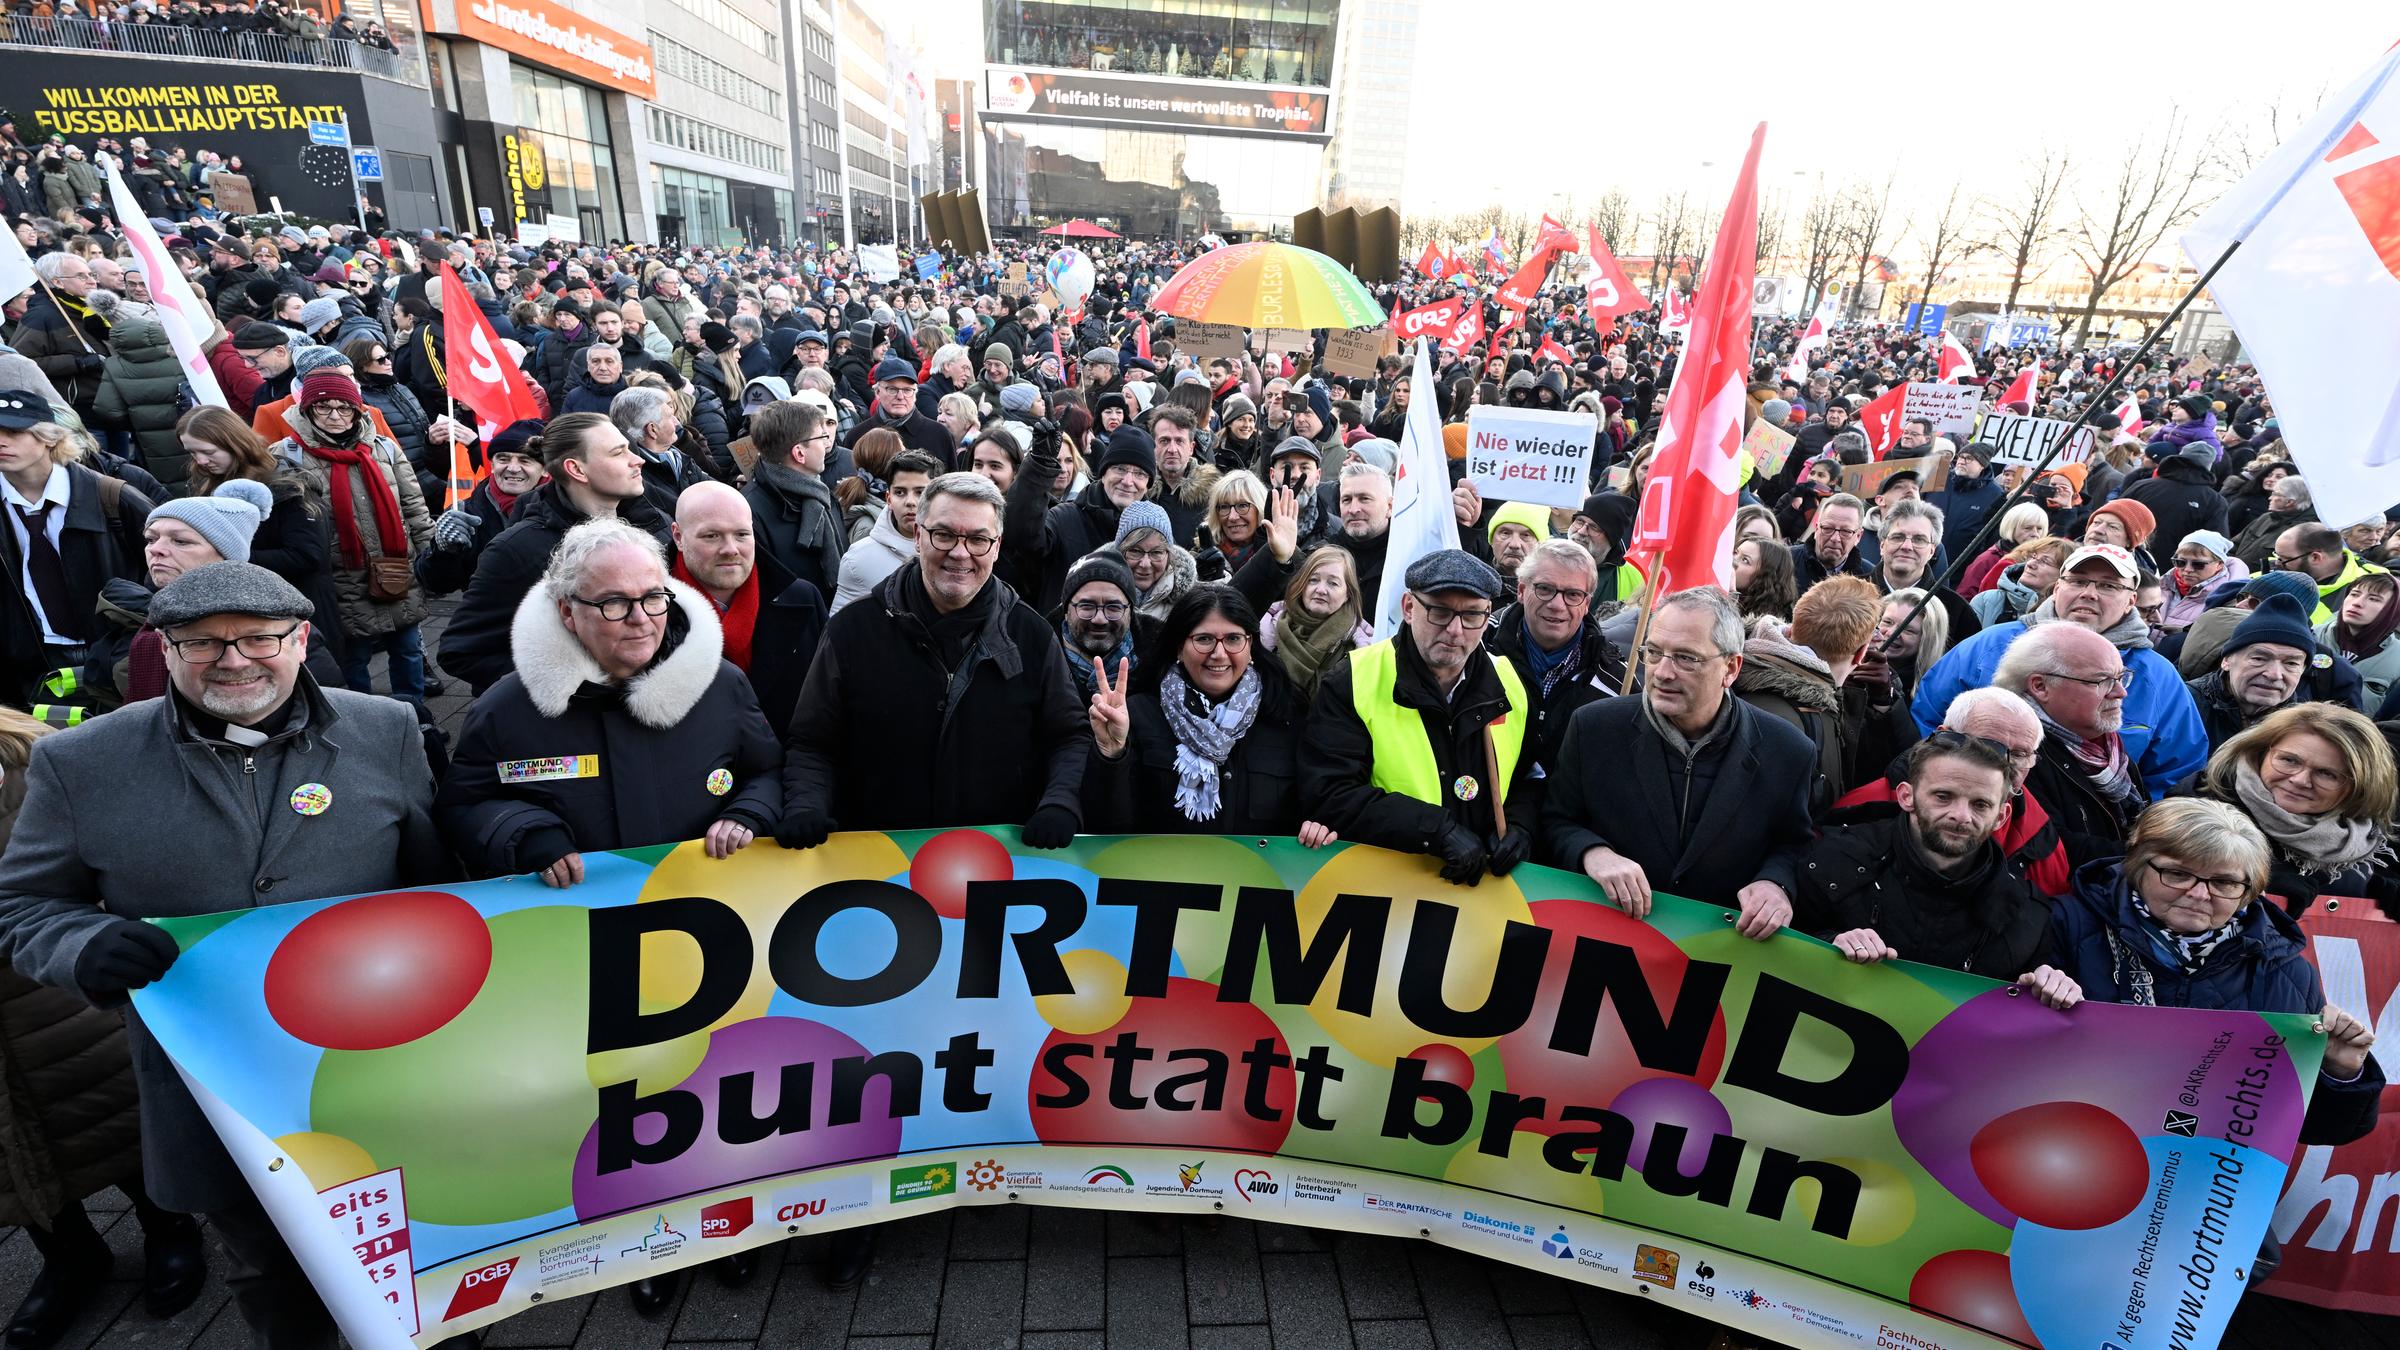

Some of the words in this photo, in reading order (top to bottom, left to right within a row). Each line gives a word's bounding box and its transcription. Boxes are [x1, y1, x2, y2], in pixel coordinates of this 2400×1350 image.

[43, 86, 200, 108] WILLKOMMEN
[199, 85, 229, 106] IN
[232, 84, 280, 105] DER
[1045, 88, 1101, 107] Vielfalt
[1103, 92, 1121, 109] ist
[1123, 97, 1169, 112] unsere
[1171, 98, 1250, 118] wertvollste
[1253, 103, 1314, 122] Trophäe.
[34, 105, 344, 134] FUSSBALLHAUPTSTADT!
[1336, 346, 1354, 360] 1933
[1475, 431, 1509, 451] Nie
[1515, 436, 1588, 459] wieder
[1471, 457, 1497, 476] ist
[1499, 460, 1548, 481] jetzt
[1554, 465, 1576, 484] !!!
[507, 758, 563, 770] DORTMUND
[587, 877, 1910, 1117] DORTMUND
[596, 1032, 994, 1177] bunt
[1035, 1032, 1344, 1131] statt
[1381, 1056, 1863, 1240] braun
[1006, 1175, 1042, 1185] Vielfalt
[1049, 1184, 1135, 1194] Auslandsgesellschaft.de
[1146, 1185, 1184, 1194] Jugendring
[1189, 1187, 1223, 1195] Dortmund
[1247, 1180, 1279, 1195] AWO
[1295, 1183, 1342, 1195] Unterbezirk
[1296, 1175, 1358, 1190] Arbeiterwohlfahrt
[895, 1188, 906, 1196] DIE
[907, 1185, 932, 1195] GRÜNEN
[1294, 1191, 1335, 1202] Dortmund
[776, 1198, 826, 1223] CDU
[830, 1200, 869, 1213] DORTMUND
[1378, 1199, 1394, 1209] DER
[1396, 1201, 1453, 1219] PARITÄTISCHE
[2133, 1150, 2182, 1280] Rechtsextremismus
[702, 1218, 729, 1231] SPD
[1463, 1210, 1521, 1233] Diakonie
[703, 1229, 730, 1237] Dortmund
[1462, 1222, 1495, 1236] Dortmund
[1496, 1229, 1511, 1239] und
[1511, 1232, 1534, 1245] Lünen
[538, 1232, 608, 1258] Evangelischer
[540, 1243, 601, 1266] Kirchenkreis
[650, 1239, 682, 1251] Katholische
[650, 1244, 682, 1256] Stadtkirche
[1579, 1248, 1604, 1261] GCJZ
[540, 1254, 589, 1274] Dortmund
[650, 1250, 677, 1261] Dortmund
[464, 1262, 511, 1289] DGB
[1577, 1257, 1619, 1275] Dortmund
[1688, 1281, 1715, 1298] esg
[2125, 1281, 2150, 1325] gegen
[1781, 1301, 1806, 1314] Gegen
[1807, 1309, 1844, 1327] Vergessen
[1792, 1313, 1805, 1323] Für
[1805, 1317, 1849, 1338] Demokratie
[1849, 1331, 1864, 1342] e.V.
[1879, 1324, 1950, 1350] Fachhoch
[2116, 1320, 2135, 1343] AK
[1876, 1335, 1915, 1350] Dort
